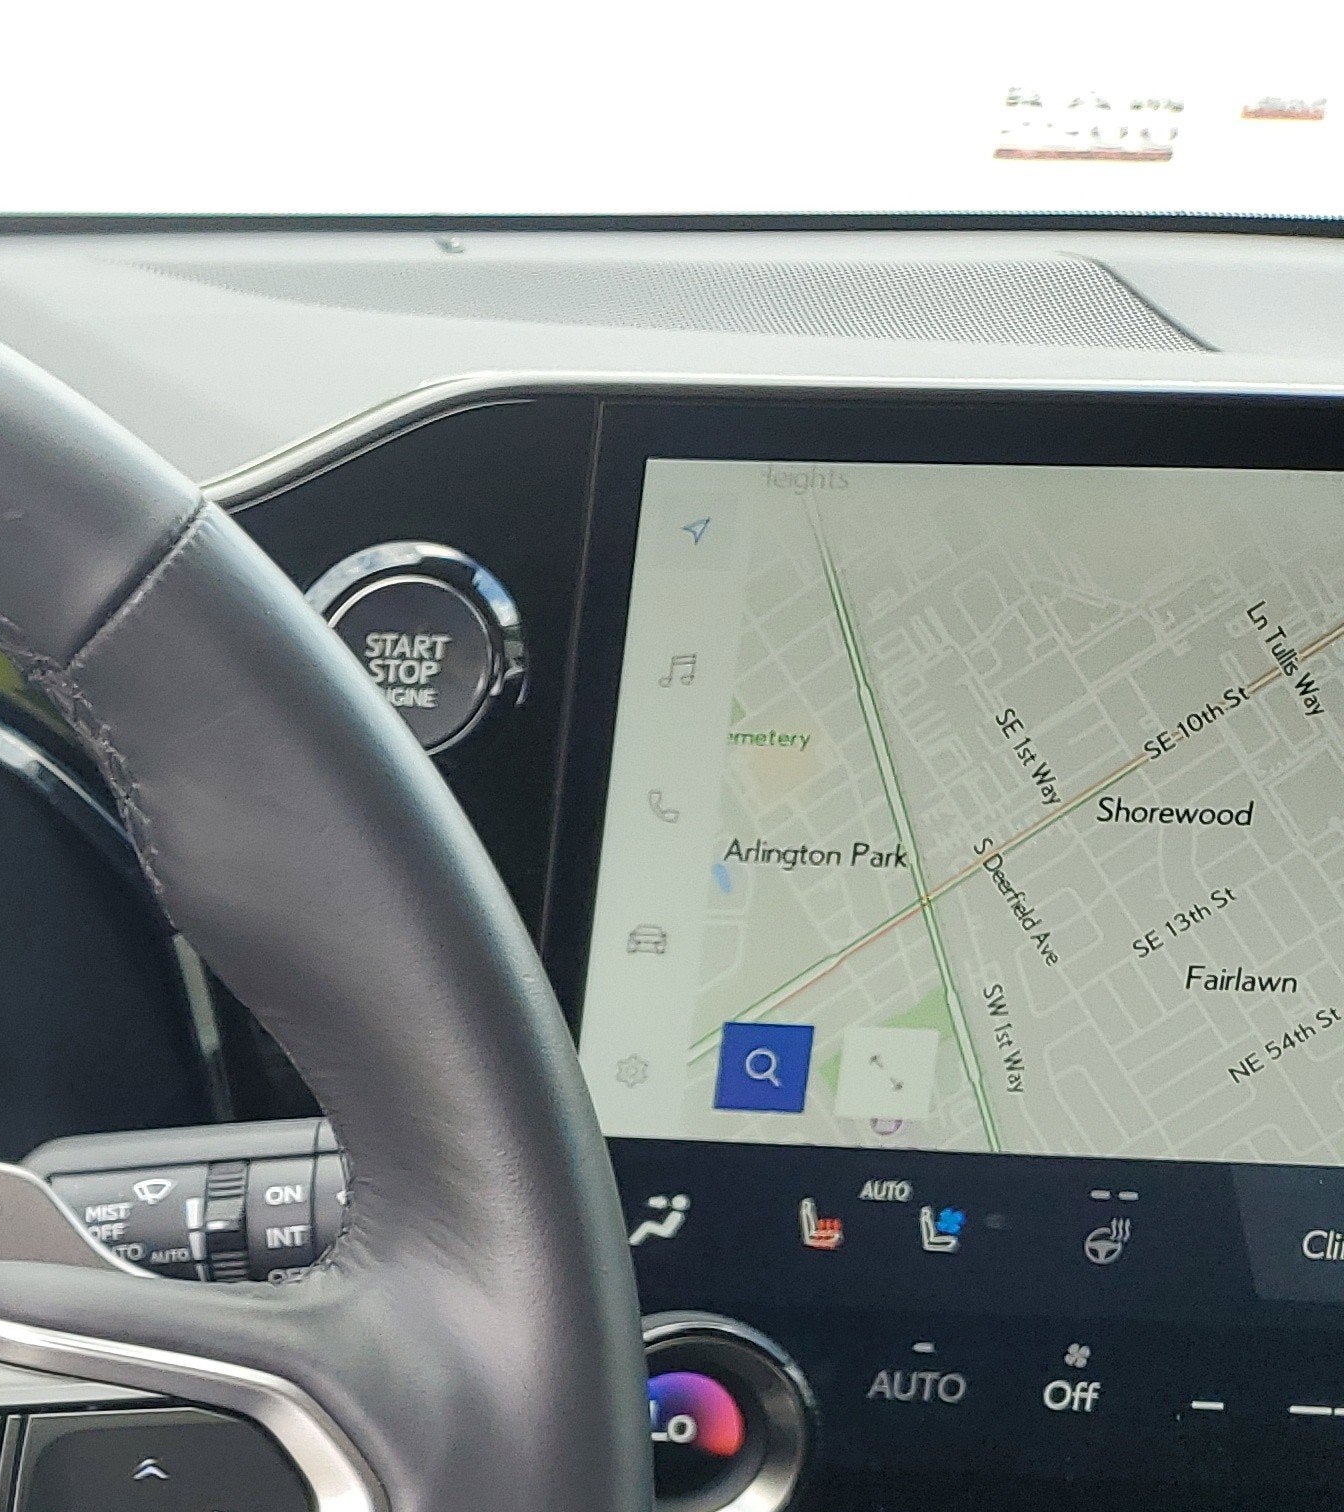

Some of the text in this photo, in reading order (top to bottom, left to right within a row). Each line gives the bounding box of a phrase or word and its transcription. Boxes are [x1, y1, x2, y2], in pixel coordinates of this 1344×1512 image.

[365, 632, 454, 660] START
[369, 659, 441, 685] STOP
[1265, 625, 1299, 676] Tullis
[1295, 672, 1325, 717] Way
[1143, 686, 1251, 760] SE 10th St
[995, 708, 1062, 806] SE 1st Way
[1096, 796, 1255, 827] Shorewood
[724, 837, 908, 870] Arlington Park
[973, 837, 1058, 968] S Deerfield Ave
[1132, 886, 1237, 959] SE 13th St
[1185, 965, 1298, 994] Fairlawn
[983, 983, 1025, 1095] SW 1st Way
[1227, 1006, 1342, 1084] NE 54th St
[265, 1184, 303, 1206] ON
[859, 1180, 911, 1202] AUTO
[85, 1202, 131, 1223] MIST
[89, 1222, 129, 1241] OFF
[265, 1225, 310, 1249] INT
[1301, 1229, 1344, 1261] Cli
[151, 1247, 190, 1263] AUTO
[867, 1370, 967, 1404] AUTO
[1043, 1379, 1101, 1413] Off
